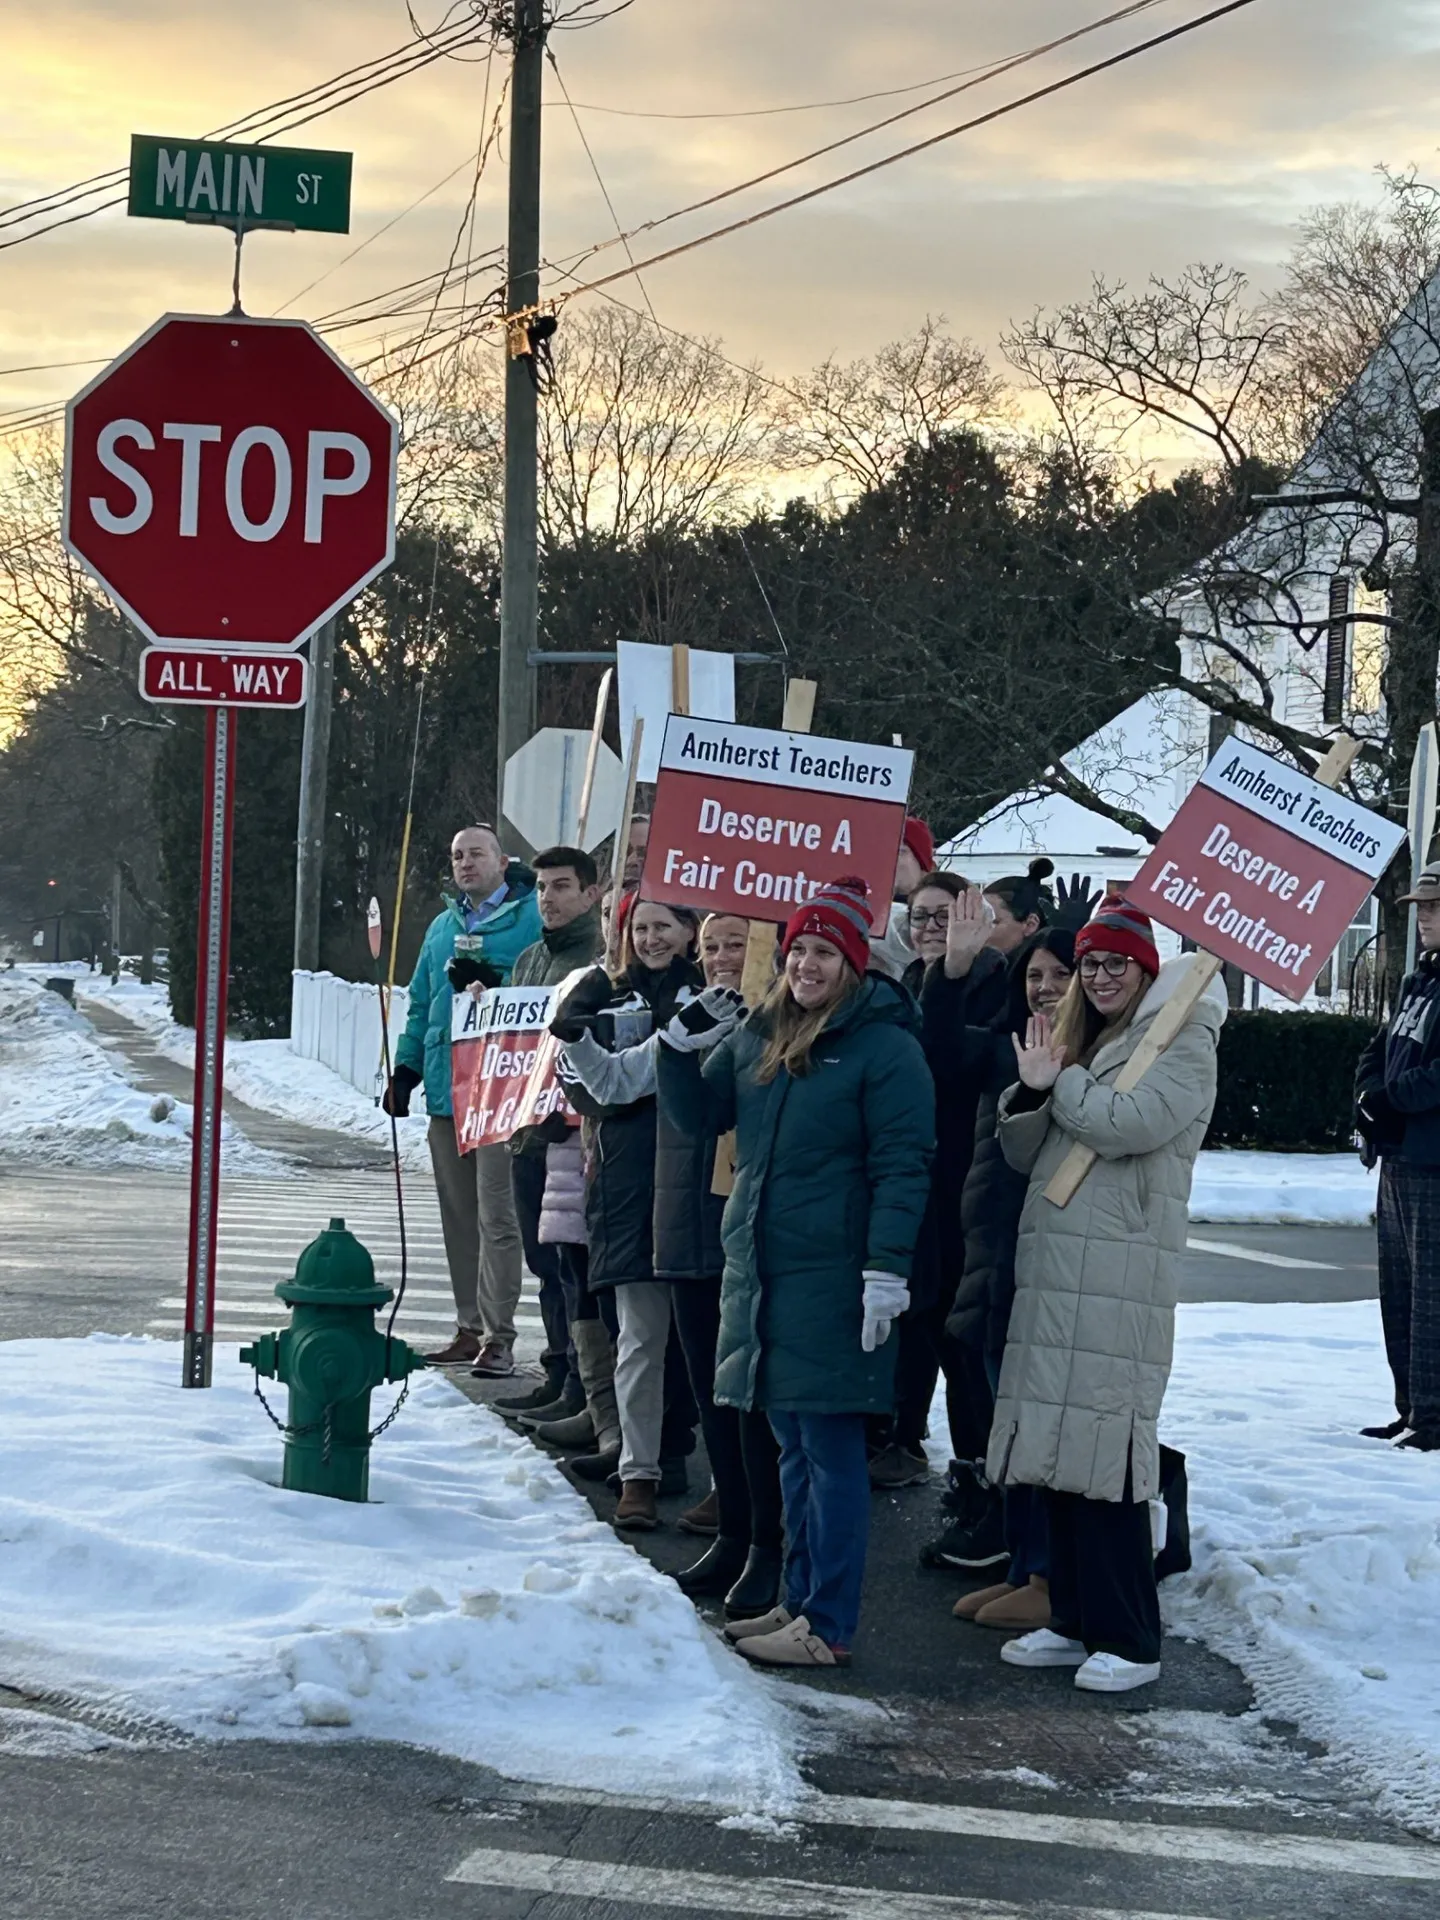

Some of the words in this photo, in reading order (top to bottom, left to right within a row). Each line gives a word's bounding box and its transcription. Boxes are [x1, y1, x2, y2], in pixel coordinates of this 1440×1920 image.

[156, 148, 265, 214] MAIN
[296, 173, 323, 204] ST
[89, 418, 371, 544] STOP
[158, 660, 212, 693] ALL
[233, 664, 289, 696] WAY
[681, 732, 780, 771] Amherst
[789, 747, 892, 787] Teachers
[698, 798, 822, 850] Deserve
[831, 819, 852, 855] A
[1220, 755, 1302, 816] Amherst
[1300, 797, 1381, 859] Teachers
[663, 848, 725, 890] Fair
[733, 860, 834, 904] Contr
[1200, 823, 1300, 901] Deserve
[1297, 880, 1325, 914] A
[1150, 860, 1206, 912] Fair
[1203, 891, 1311, 976] Contract
